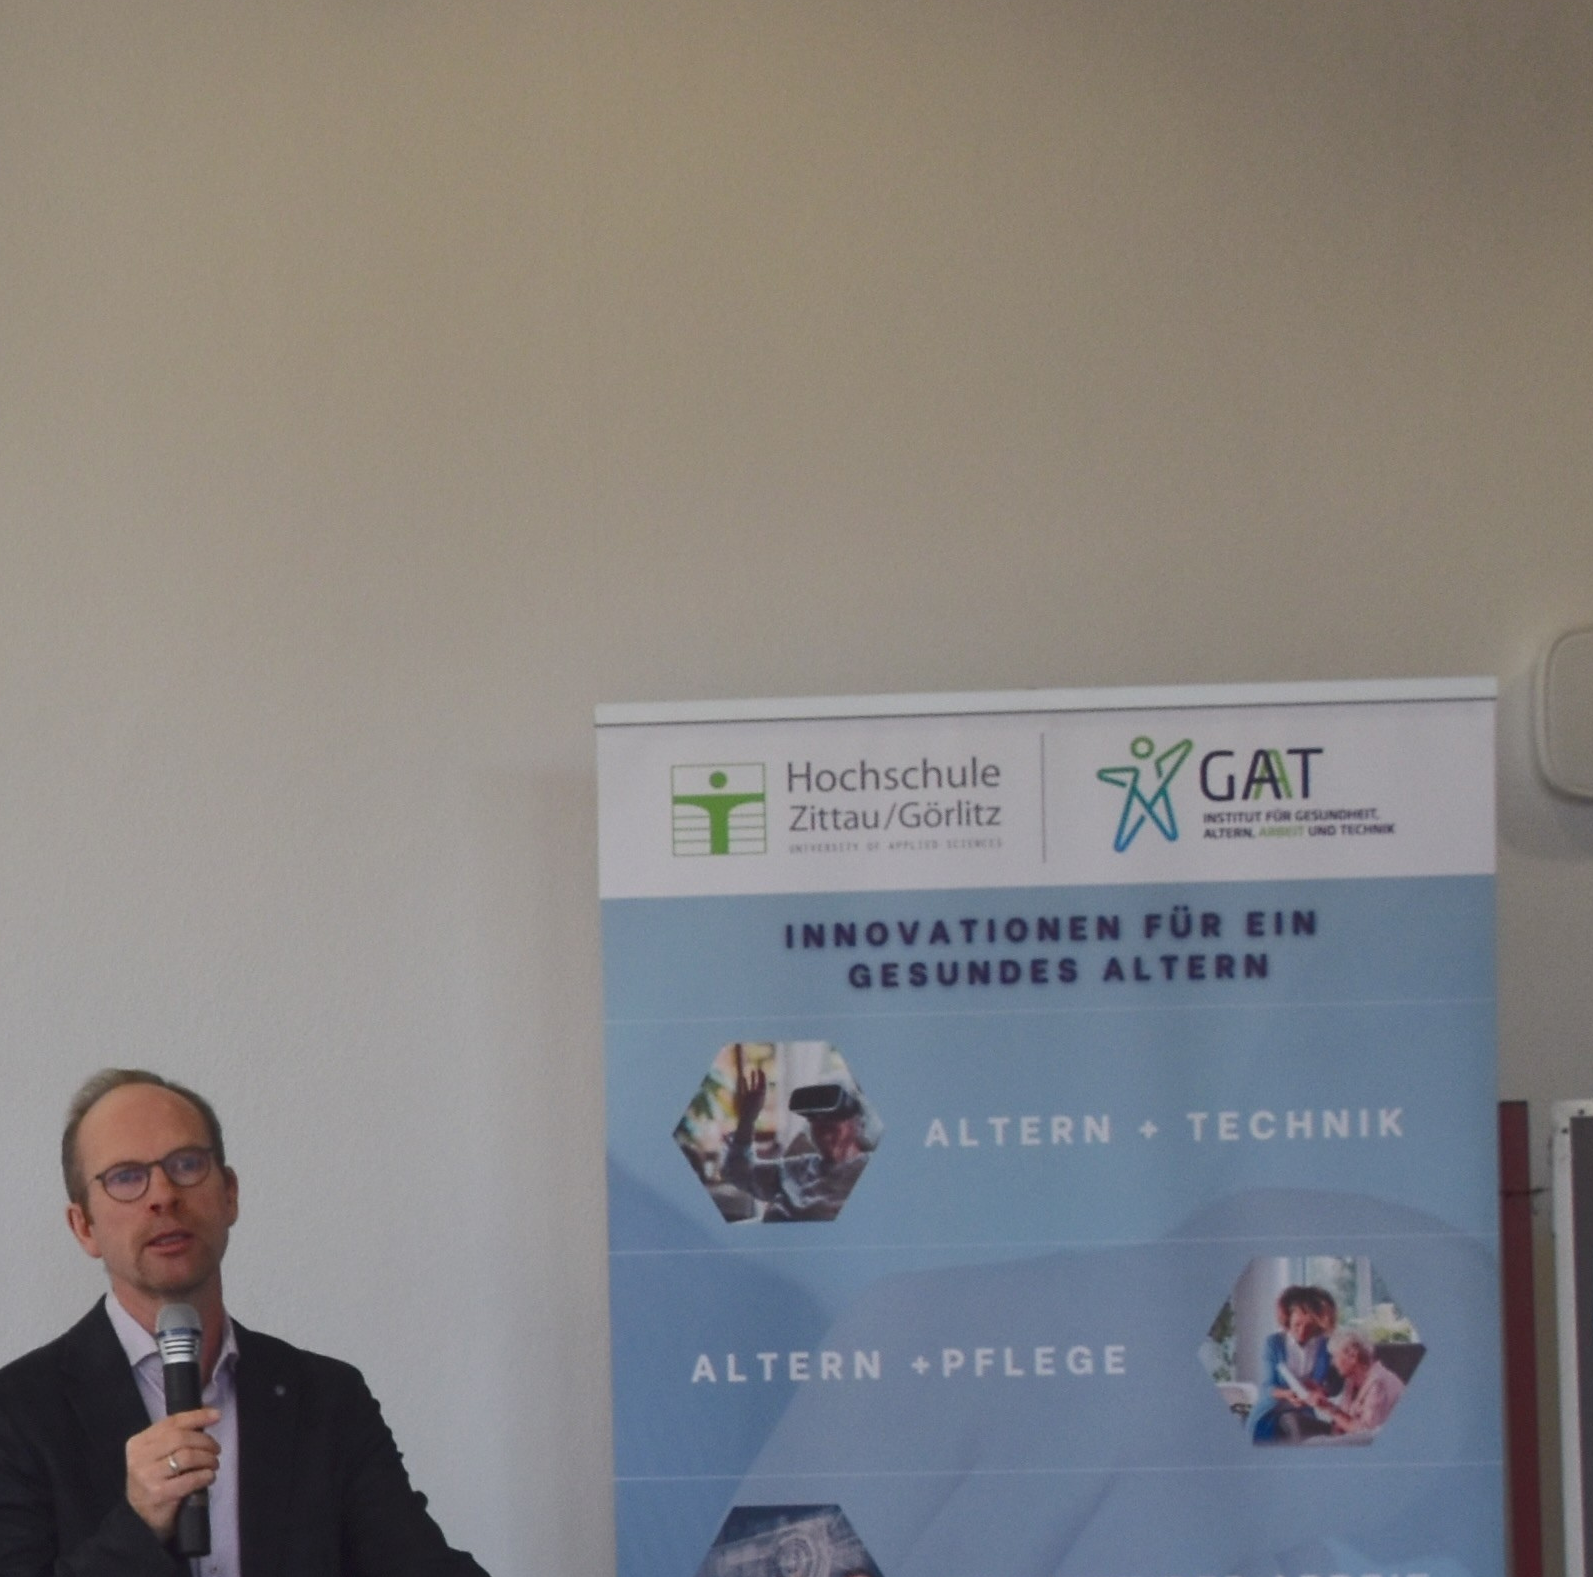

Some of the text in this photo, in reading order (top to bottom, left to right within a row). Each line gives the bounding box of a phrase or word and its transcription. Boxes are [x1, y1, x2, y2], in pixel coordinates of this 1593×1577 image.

[788, 757, 1000, 792] Hochschule
[1203, 812, 1261, 823] INSTITUT
[1265, 809, 1291, 821] FÜR
[1259, 826, 1304, 837] ARBEIT
[1308, 825, 1336, 836] UND
[1341, 824, 1395, 835] TECHNIK
[785, 905, 1316, 949] INNOVATIONEN FÜR EIN
[848, 954, 1268, 989] GESUNDES ALTERN
[925, 1115, 1110, 1147] ALTERN
[1187, 1108, 1402, 1141] TECHNIK
[692, 1351, 879, 1383] ALTERN
